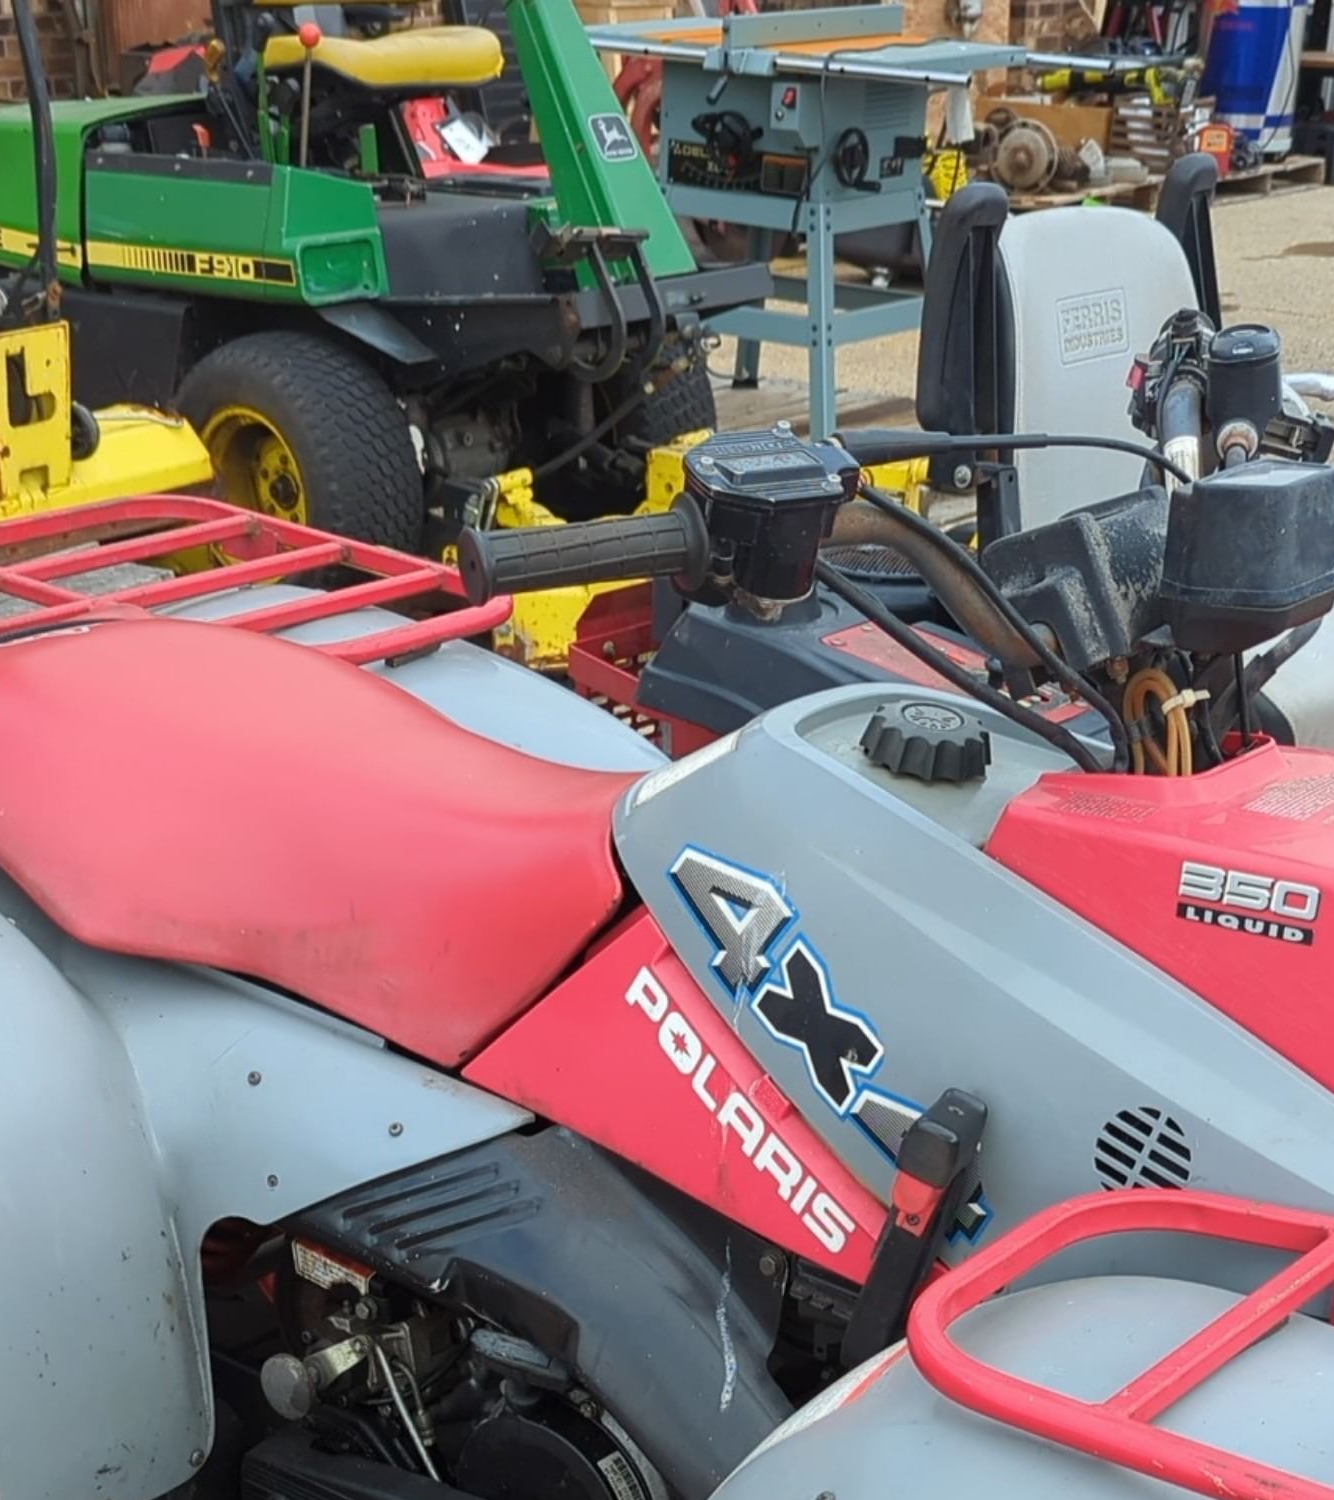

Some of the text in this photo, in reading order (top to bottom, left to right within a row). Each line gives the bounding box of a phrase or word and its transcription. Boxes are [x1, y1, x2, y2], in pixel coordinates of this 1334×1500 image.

[195, 253, 255, 281] F910
[1061, 299, 1122, 335] FERRIS
[1064, 327, 1124, 353] INDUSTRIES
[1178, 860, 1322, 922] 350
[1185, 905, 1306, 944] LIQUID
[625, 966, 857, 1254] POLARIS
